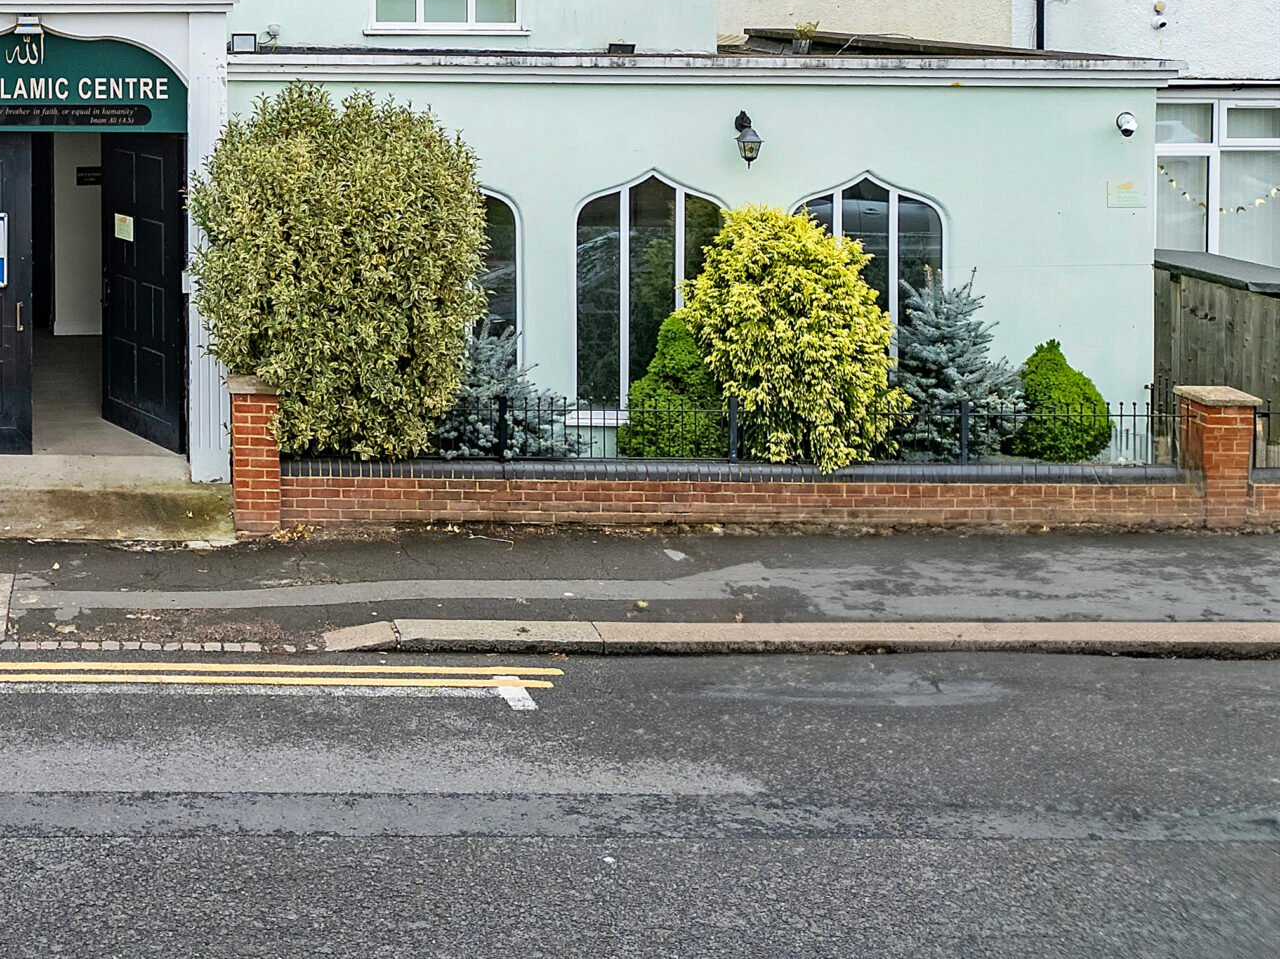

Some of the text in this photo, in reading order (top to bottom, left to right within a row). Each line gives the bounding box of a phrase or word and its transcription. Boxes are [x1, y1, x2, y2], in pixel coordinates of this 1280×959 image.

[5, 33, 45, 65] الله
[78, 77, 169, 100] CENTRE
[5, 107, 30, 115] brother
[41, 107, 59, 117] faith,
[71, 107, 91, 116] equal
